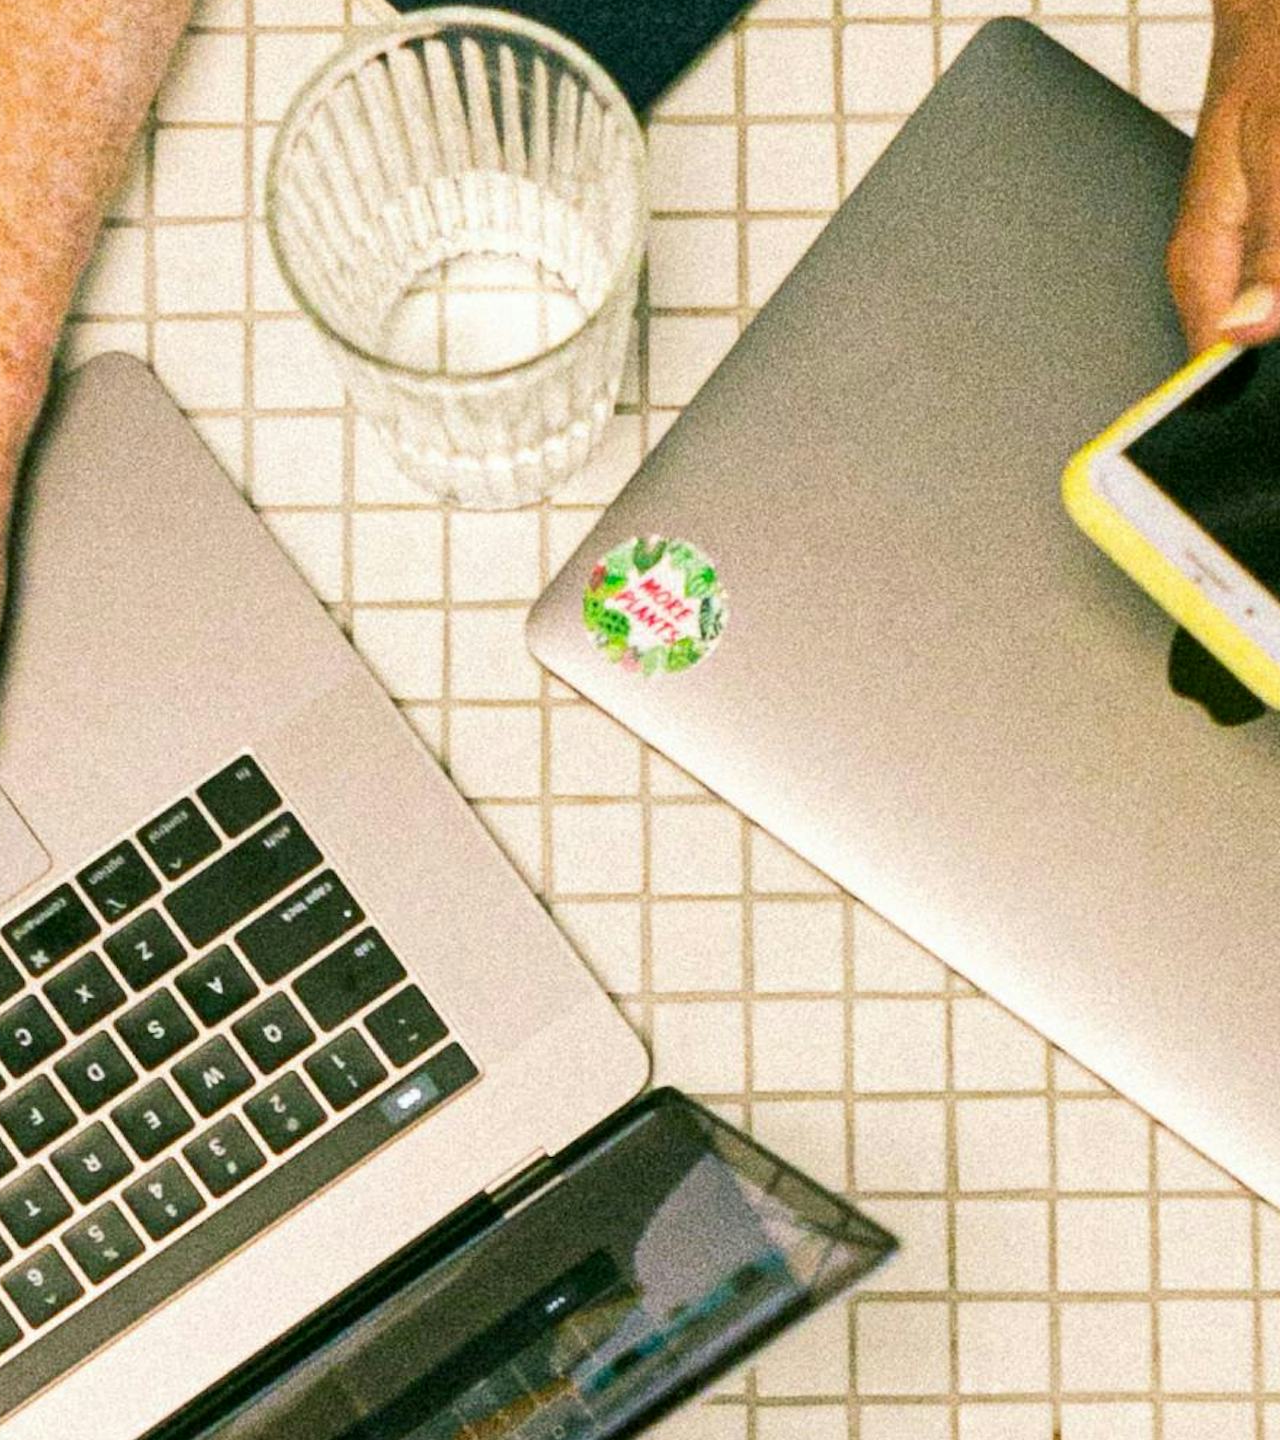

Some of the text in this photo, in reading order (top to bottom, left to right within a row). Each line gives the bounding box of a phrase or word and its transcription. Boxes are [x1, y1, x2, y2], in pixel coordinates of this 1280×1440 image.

[639, 577, 694, 621] MORE
[614, 591, 679, 645] PLANTS
[134, 940, 154, 961] Z
[74, 984, 94, 1003] X
[206, 976, 224, 994] A
[14, 1027, 33, 1047] C
[146, 1019, 165, 1039] S
[261, 1023, 283, 1043] Q
[330, 1053, 346, 1069] 1
[86, 1061, 106, 1082] D
[202, 1066, 225, 1089] W
[268, 1093, 287, 1113] 2
[29, 1106, 45, 1126] F
[143, 1109, 162, 1130] E
[208, 1137, 226, 1157] 3
[82, 1153, 102, 1172] R
[147, 1181, 163, 1200] 4
[24, 1199, 41, 1217] T
[86, 1223, 105, 1243] 5
[26, 1267, 44, 1287] 6
